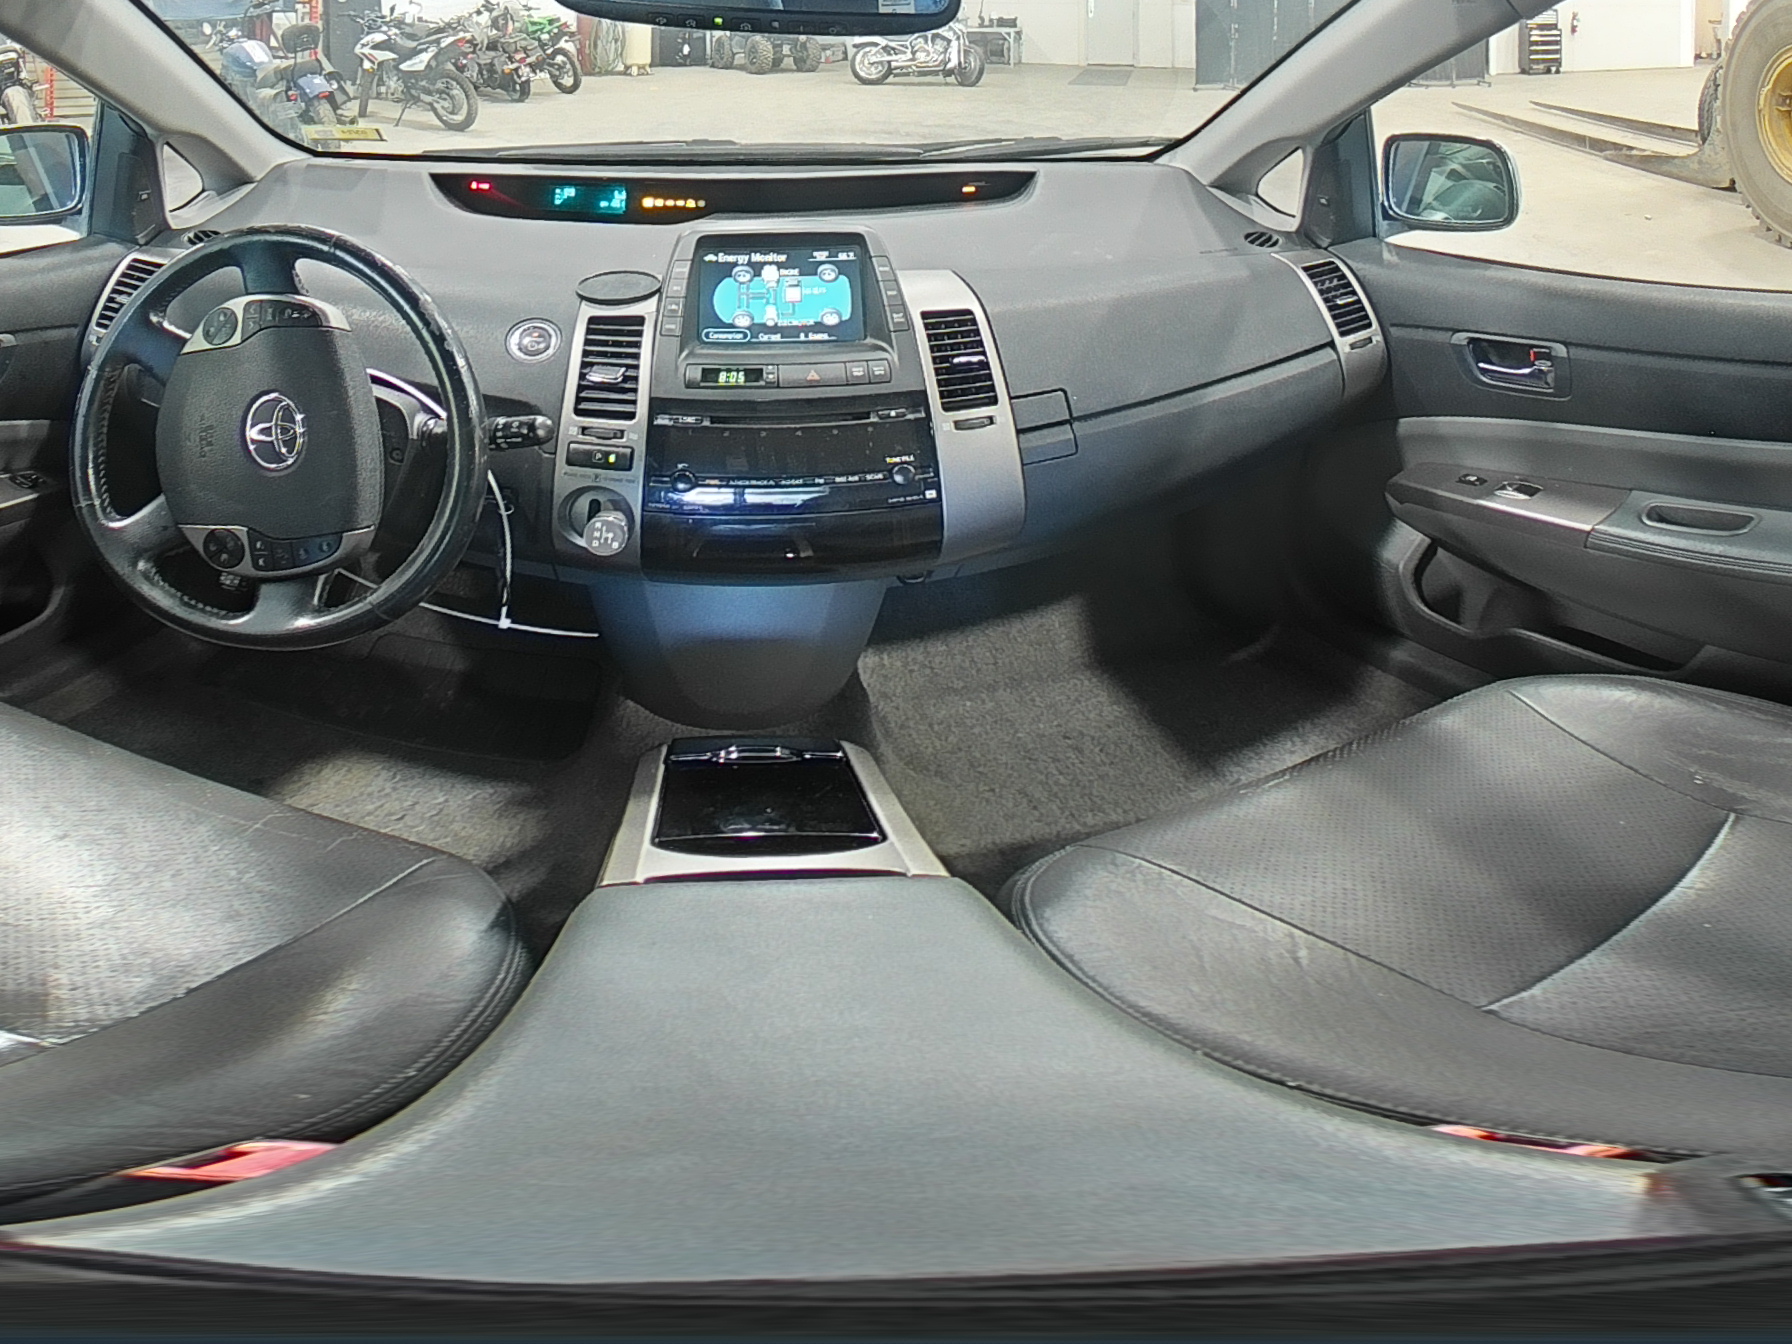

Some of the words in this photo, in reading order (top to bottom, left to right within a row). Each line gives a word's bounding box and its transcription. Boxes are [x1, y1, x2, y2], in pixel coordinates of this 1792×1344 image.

[717, 252, 750, 265] Energy
[751, 251, 788, 263] Monitor
[718, 371, 745, 384] 8:05
